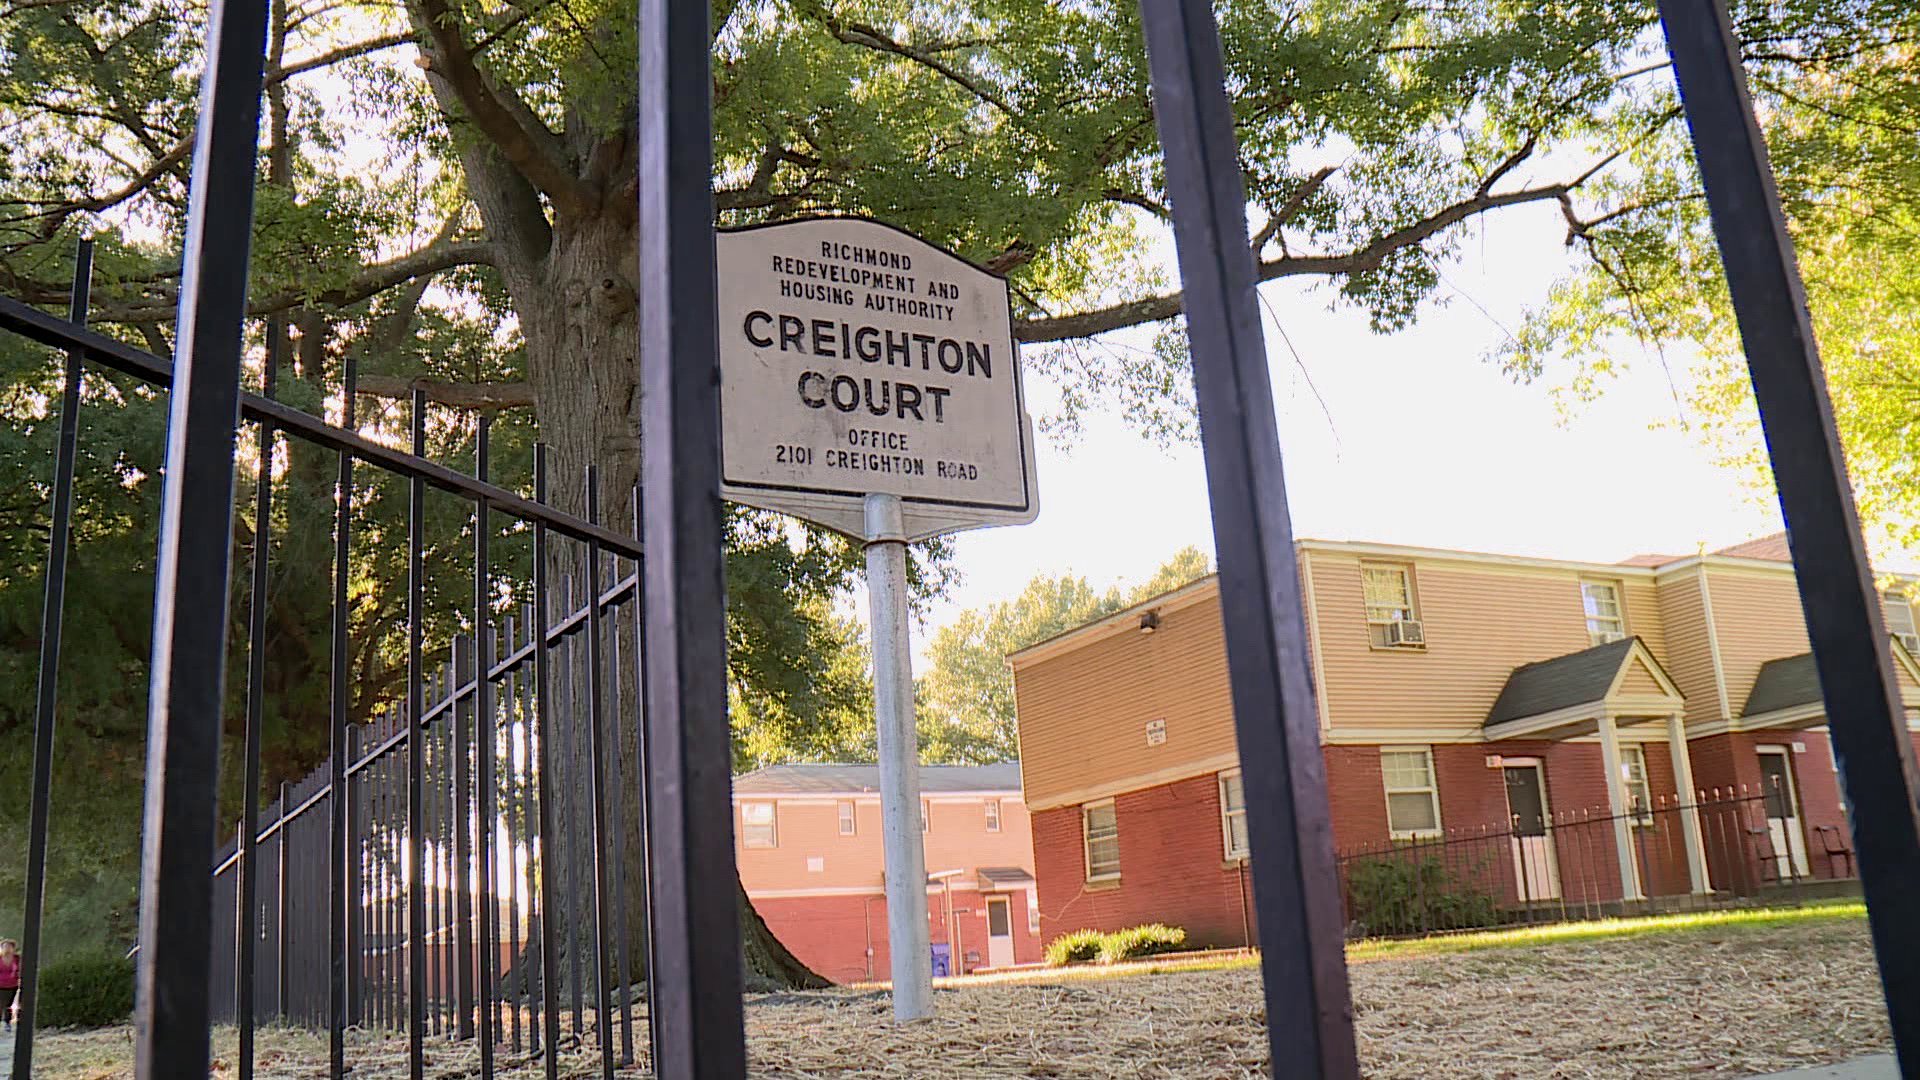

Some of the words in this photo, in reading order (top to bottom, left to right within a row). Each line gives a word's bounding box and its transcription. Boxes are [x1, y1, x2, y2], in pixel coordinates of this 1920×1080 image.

[821, 241, 911, 271] RICHMOND
[773, 255, 915, 294] REDEVELOPMENT
[928, 281, 959, 300] AND
[780, 279, 854, 307] HOUSING
[865, 293, 954, 321] AUTHORITY
[744, 310, 992, 379] CREIGHTON
[798, 371, 950, 423] COURT
[849, 429, 909, 451] OFFICE
[776, 445, 812, 466] 2101
[826, 450, 924, 476] CREIGHTON
[938, 461, 978, 481] ROAD
